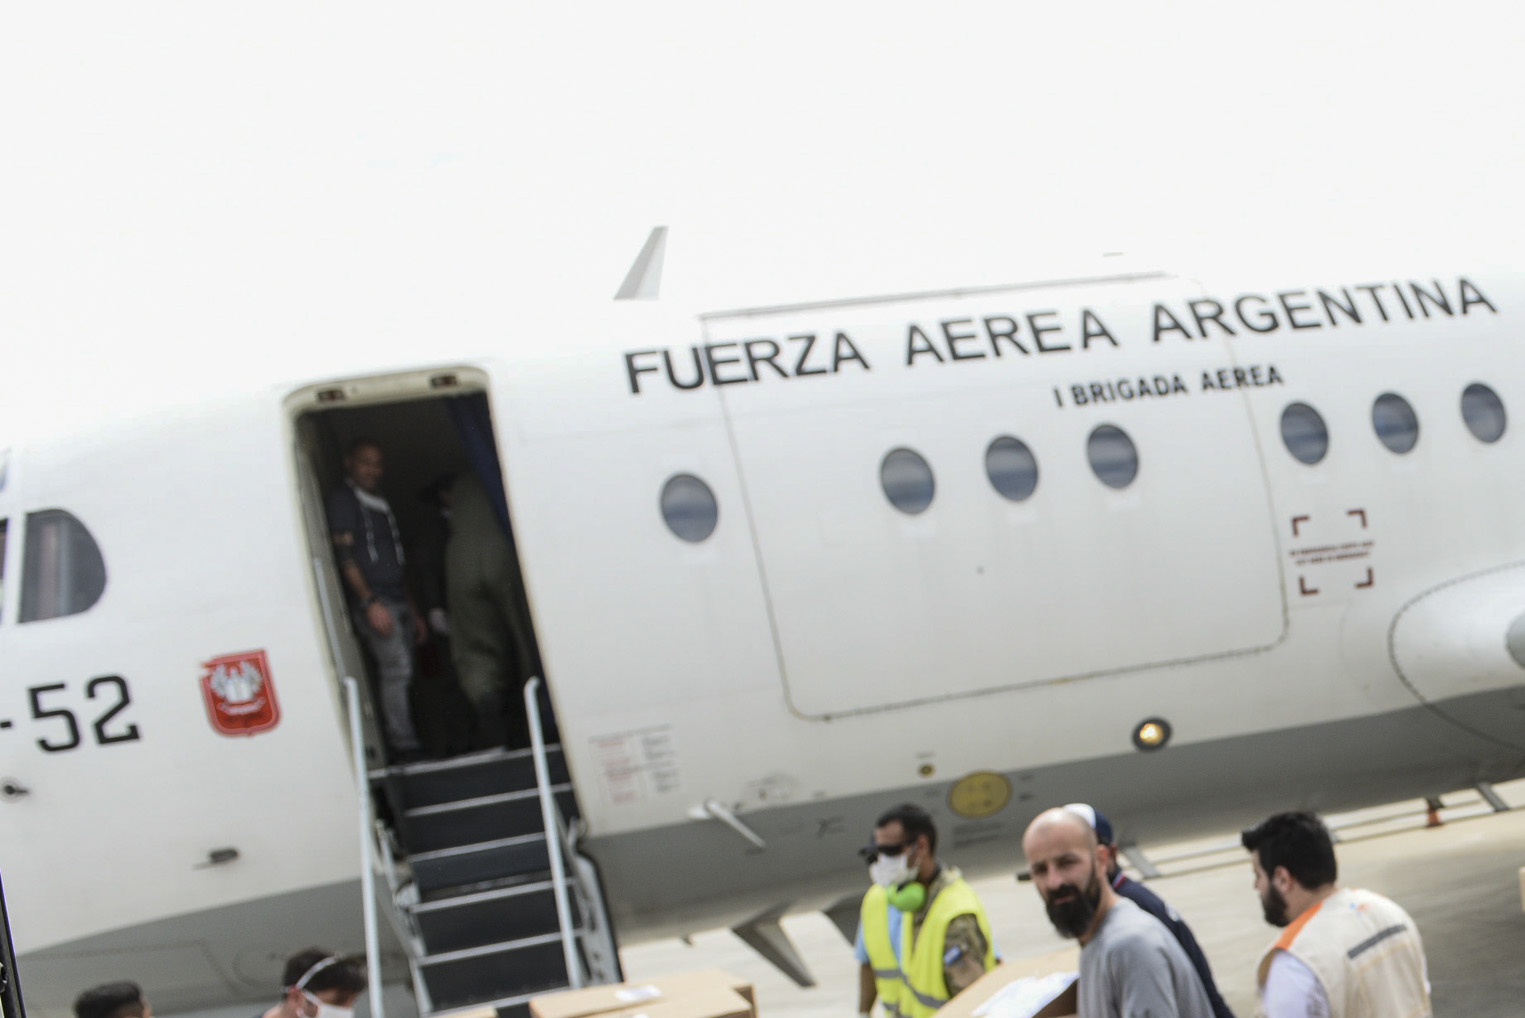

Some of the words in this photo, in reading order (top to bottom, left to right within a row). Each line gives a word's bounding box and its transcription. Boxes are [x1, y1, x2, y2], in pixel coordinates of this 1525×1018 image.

[624, 333, 870, 395] FUERZA
[905, 310, 1119, 367] AEREA
[1152, 279, 1497, 342] ARGENTINA
[1053, 388, 1064, 408] I
[1070, 375, 1188, 407] BRIGADA
[1201, 365, 1284, 393] AEREA
